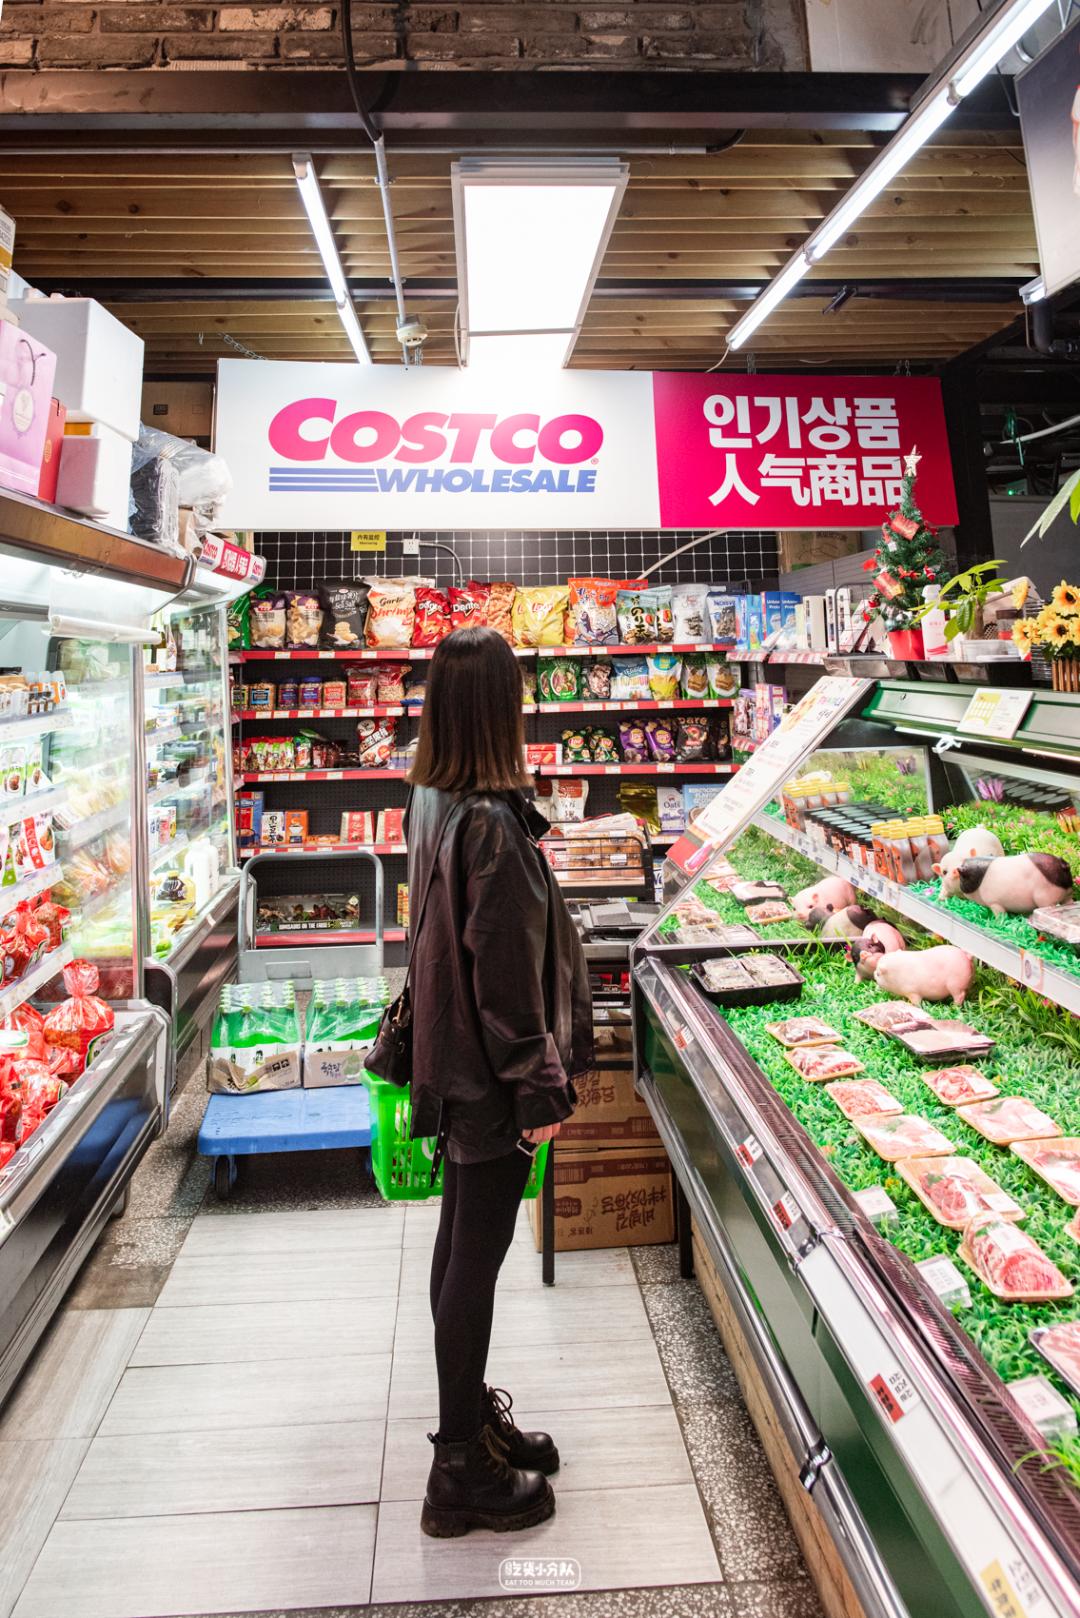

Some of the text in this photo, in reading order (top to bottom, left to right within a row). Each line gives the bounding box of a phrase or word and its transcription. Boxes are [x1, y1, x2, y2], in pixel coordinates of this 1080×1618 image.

[268, 398, 604, 464] COSTCO
[703, 394, 901, 450] 인기상품
[375, 469, 597, 494] WHOLESALE
[453, 602, 481, 614] Doritos
